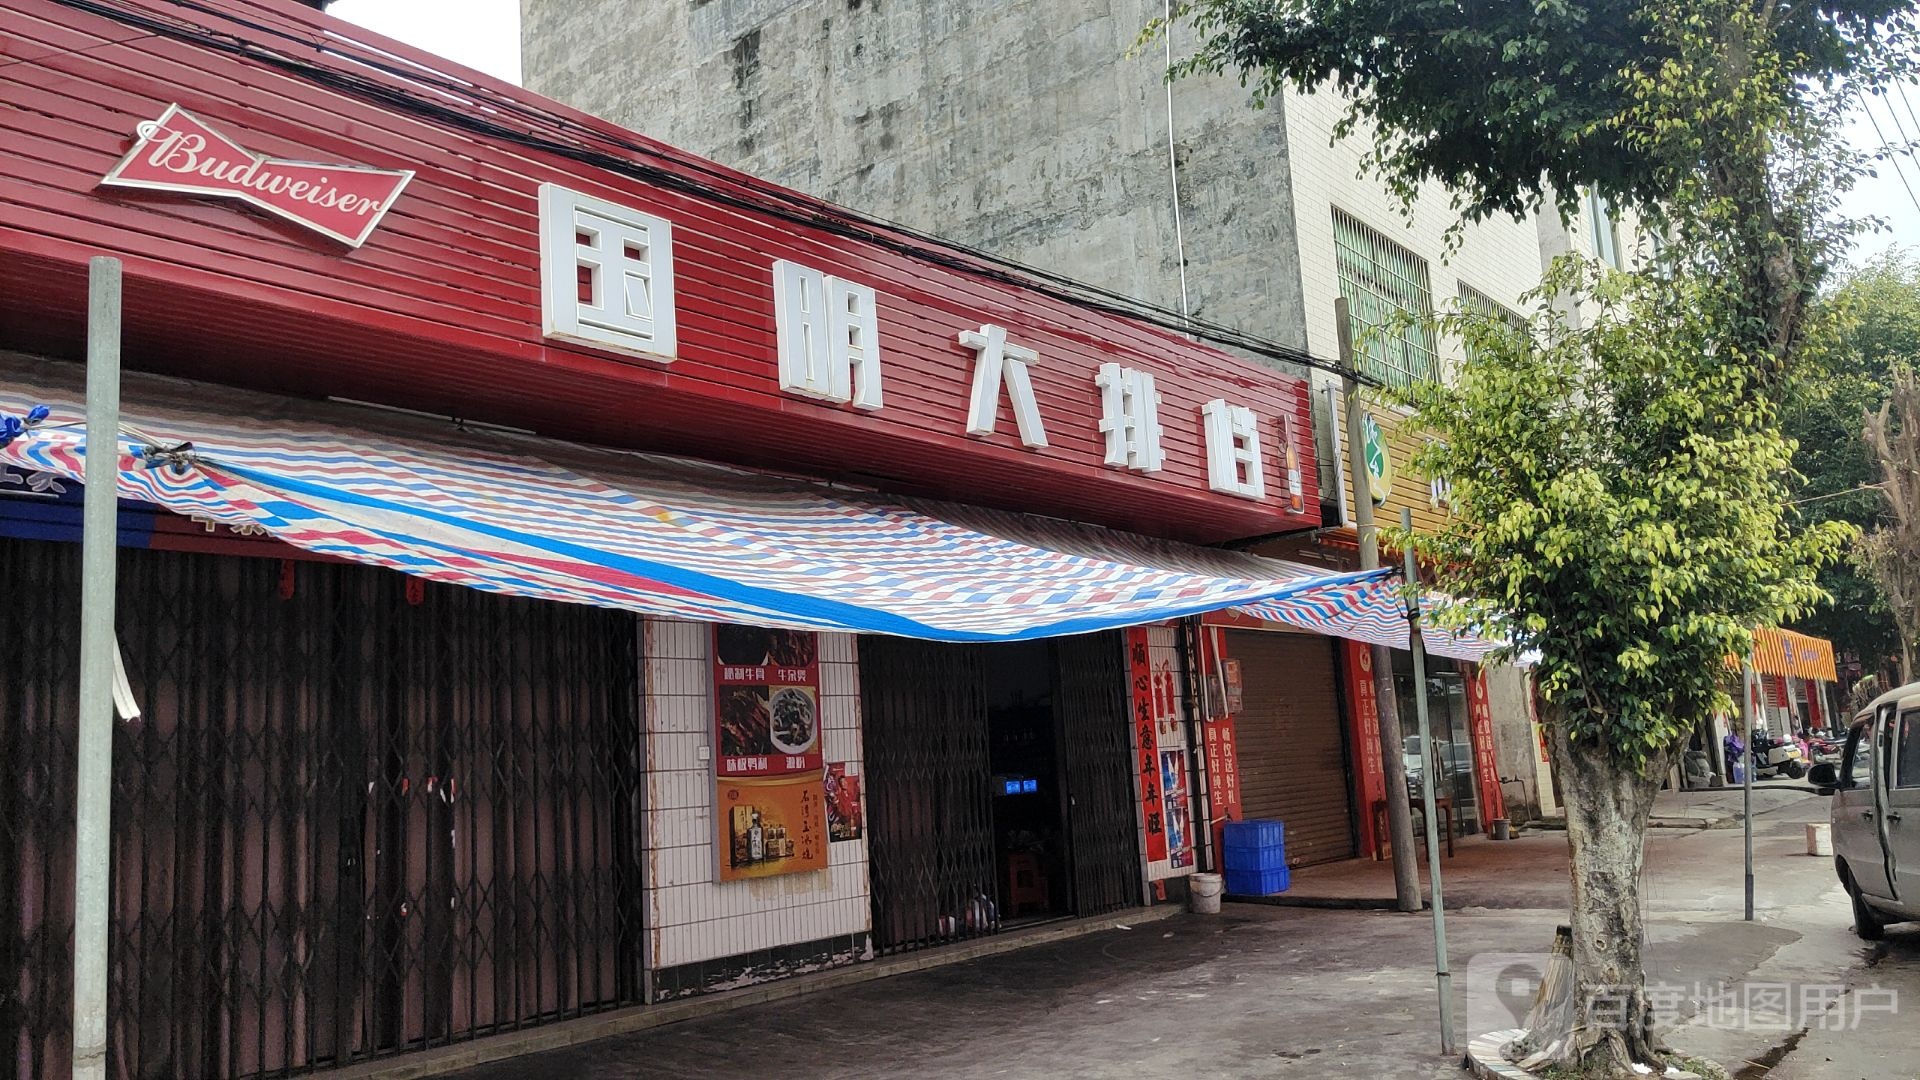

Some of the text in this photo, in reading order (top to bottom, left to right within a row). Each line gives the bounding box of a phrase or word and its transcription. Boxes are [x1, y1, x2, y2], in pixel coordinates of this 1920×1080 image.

[136, 120, 384, 217] Budweiser
[538, 181, 1266, 502] 国明大排档
